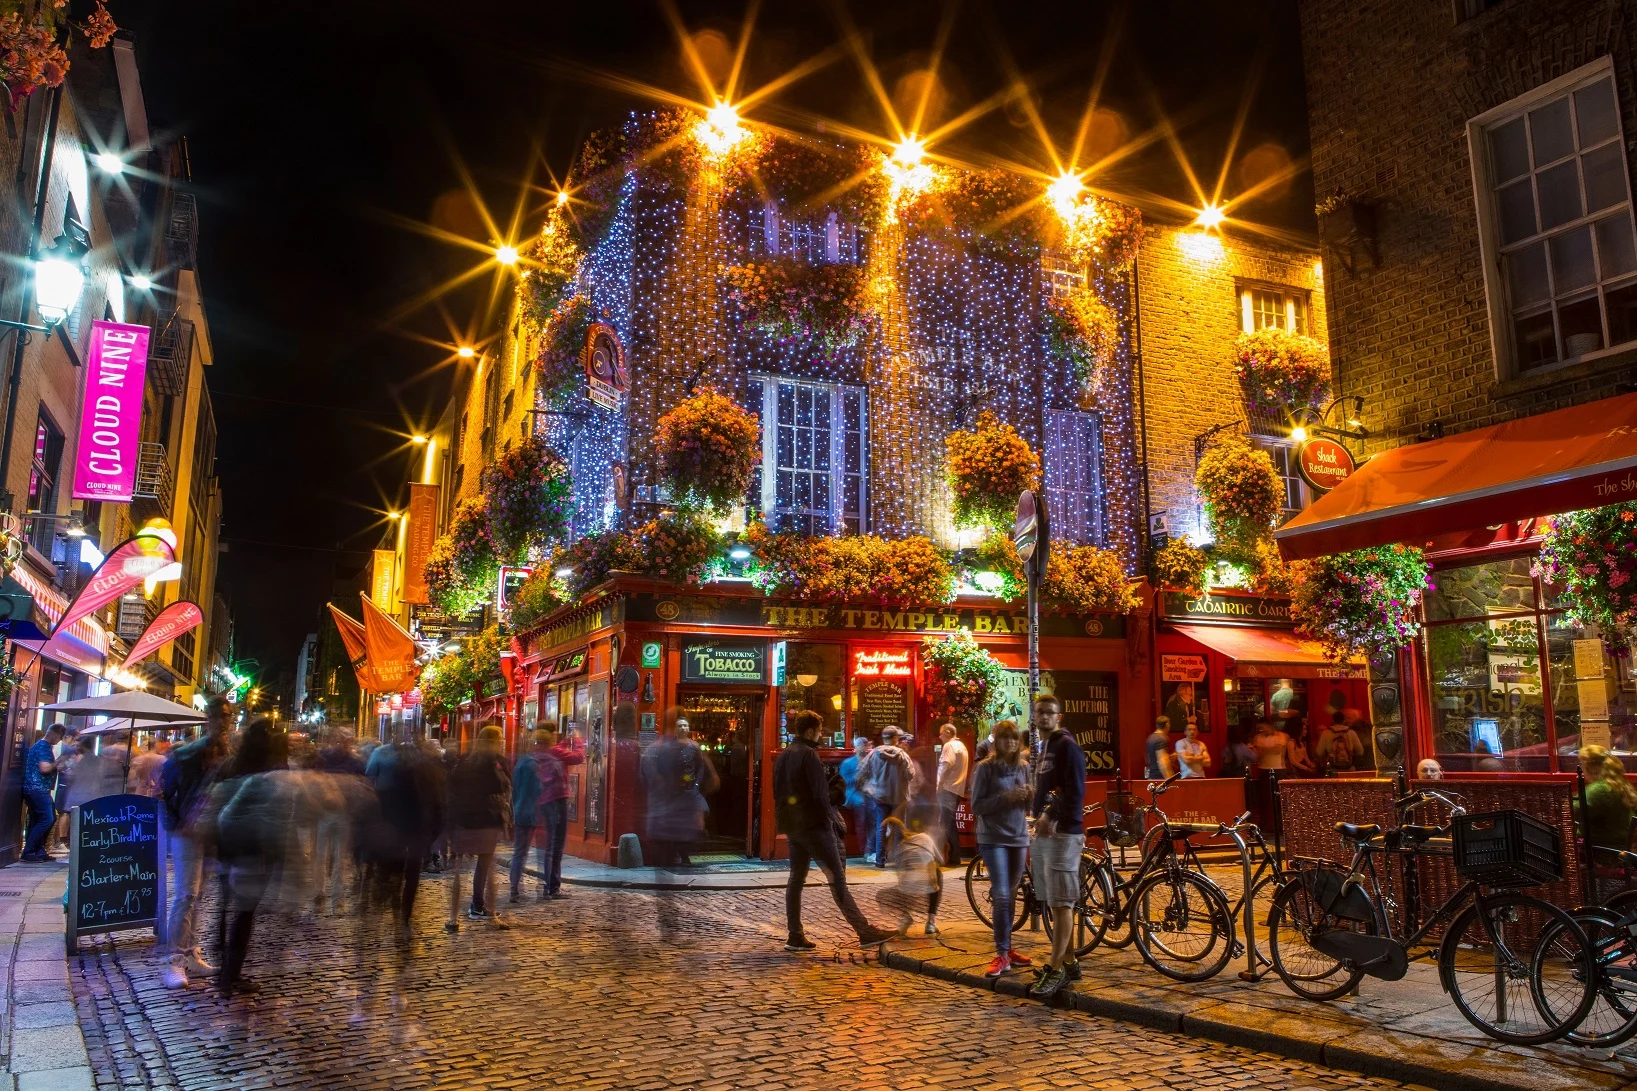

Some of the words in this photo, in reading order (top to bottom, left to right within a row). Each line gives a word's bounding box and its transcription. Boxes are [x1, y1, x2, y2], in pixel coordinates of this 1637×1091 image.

[98, 329, 138, 388] NINE
[596, 381, 615, 395] DUBLIN
[88, 395, 123, 476] CLOUD
[1308, 462, 1348, 477] Restaurant
[86, 481, 106, 489] CLOUD
[107, 483, 122, 491] NINE
[1594, 477, 1618, 496] The
[659, 605, 674, 615] 48
[146, 622, 175, 644] CLOUD
[175, 607, 197, 625] NINE
[585, 611, 602, 633] BAR
[763, 606, 828, 627] THE
[841, 609, 960, 631] TEMPLE
[974, 615, 1029, 634] BAR
[694, 653, 755, 675] TOBACCO
[855, 651, 909, 663] Traditional
[1164, 656, 1176, 665] Beer
[1177, 657, 1198, 666] Garden
[372, 664, 412, 675] TEMPLE
[854, 662, 879, 675] Irish
[882, 663, 911, 675] Music
[1164, 665, 1187, 674] Smoking
[1317, 668, 1340, 679] THE
[382, 673, 403, 681] BAR
[1004, 676, 1053, 688] TEMLE
[864, 681, 889, 693] TEMPLE
[890, 683, 902, 693] BAR
[1088, 685, 1109, 699] THE
[1065, 699, 1109, 714] EMPEROR
[1097, 715, 1109, 728] OF
[1075, 729, 1112, 746] LIQUORS
[83, 809, 119, 826] Mexico
[126, 805, 155, 823] Rome
[1200, 815, 1218, 824] BAR
[81, 831, 109, 850] Early
[109, 827, 133, 845] Bird
